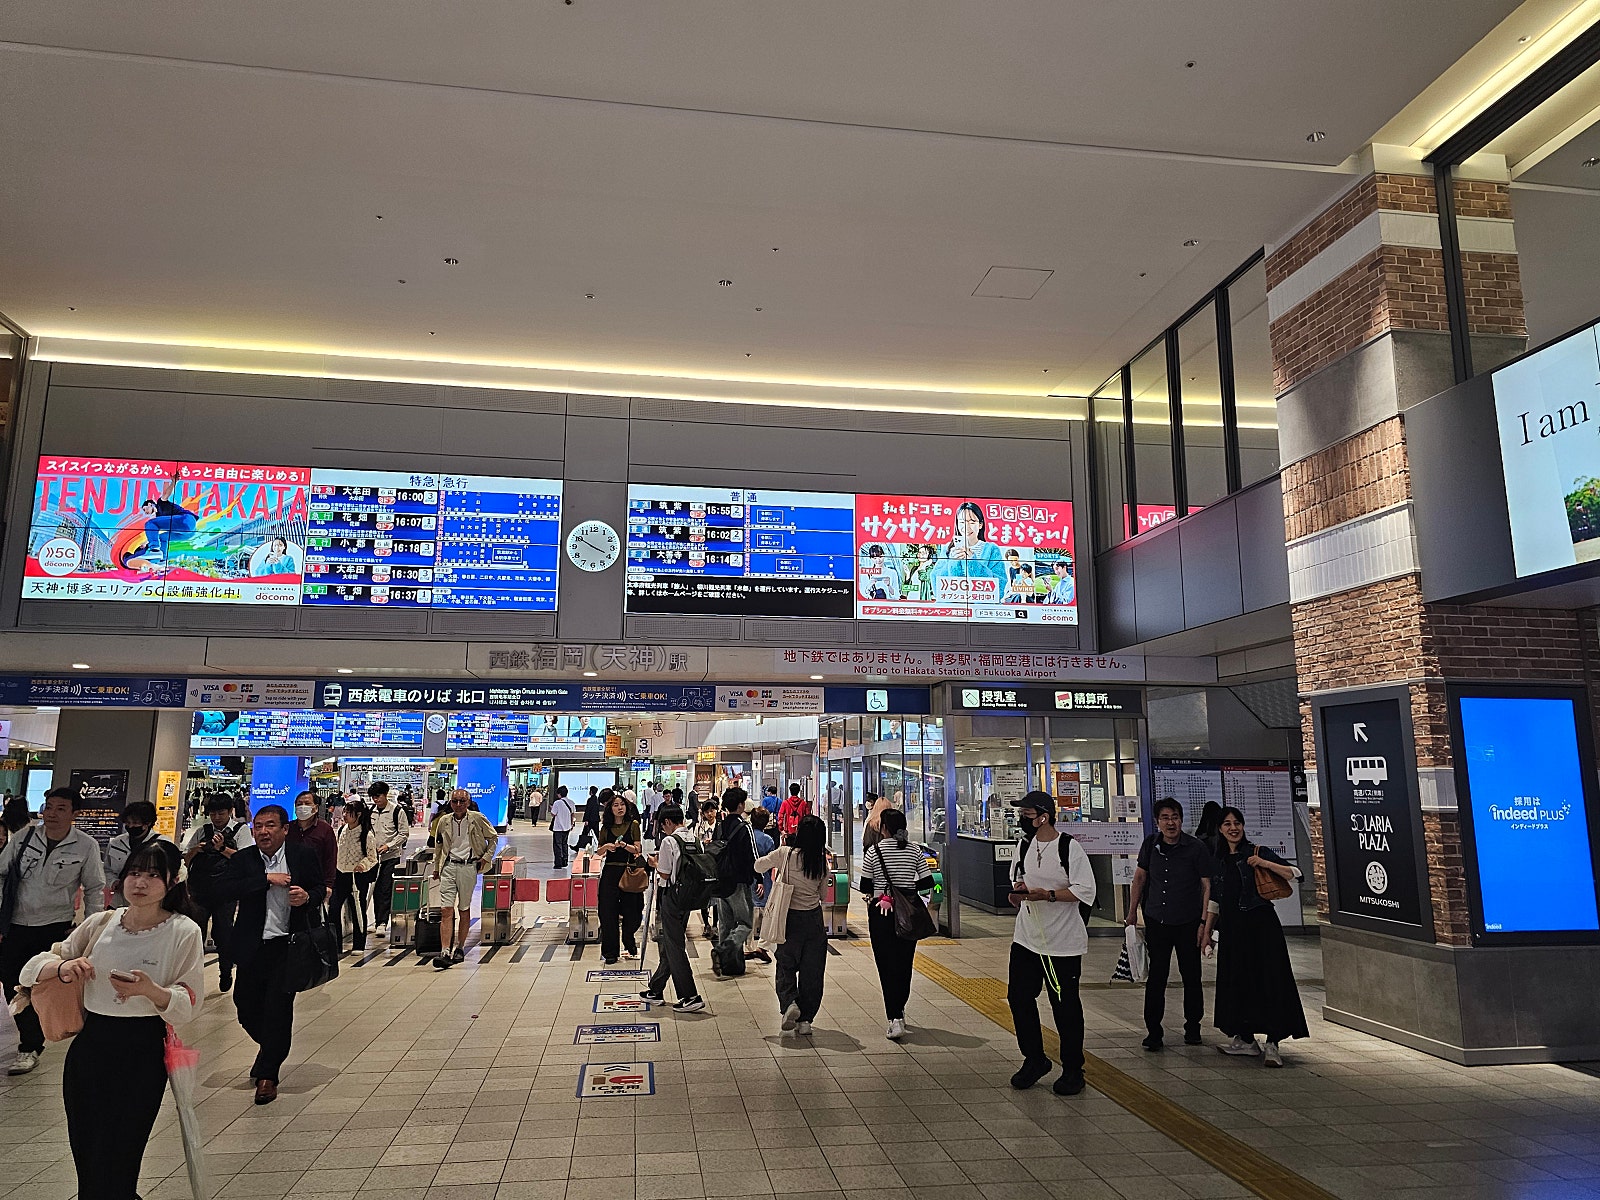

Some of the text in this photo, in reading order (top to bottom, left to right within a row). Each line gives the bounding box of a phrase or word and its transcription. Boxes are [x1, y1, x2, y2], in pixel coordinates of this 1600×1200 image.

[1517, 411, 1534, 446] I
[1538, 399, 1590, 439] am
[46, 460, 170, 477] スイスイつながるから、
[342, 487, 371, 496] 大牟田
[397, 492, 424, 501] 16:00
[181, 481, 308, 522] HAKATA
[706, 506, 731, 515] 15:55
[882, 501, 953, 516] 私もドコモの
[395, 517, 422, 527] 16:07
[860, 515, 951, 541] サクサクが
[706, 530, 731, 540] 16:02
[987, 522, 1070, 545] とまらない!
[54, 546, 76, 560] 5G
[394, 543, 420, 553] 16:18
[44, 560, 75, 568] docomo
[706, 555, 730, 564] 16:14
[336, 565, 365, 574] 大牟田
[391, 569, 418, 579] 16:30
[950, 580, 993, 592] 5G SA
[255, 592, 296, 602] docomo
[390, 590, 416, 600] 16:37
[1042, 614, 1074, 622] docomo
[784, 650, 1128, 670] 地下鉄ではありません。 博多駅・福岡空港には行きません。
[854, 666, 873, 674] NOT
[876, 667, 888, 676] go
[904, 666, 936, 675] Hakata
[938, 667, 970, 676] Station
[984, 668, 1022, 677] Fukuoka
[1024, 669, 1057, 678] Airport
[30, 686, 70, 694] タッチ決済
[348, 688, 485, 704] 西鉄電車のりば 北口
[582, 692, 616, 700] タッチ決済
[982, 690, 1109, 706] 授乳室 精算所
[640, 739, 648, 748] 3
[1514, 796, 1541, 806] 採用は
[1491, 806, 1565, 820] indeed PLUS
[1350, 814, 1394, 834] SOLARIA
[1358, 832, 1390, 852] PLAZA
[1360, 896, 1400, 909] MITSUKOSHI
